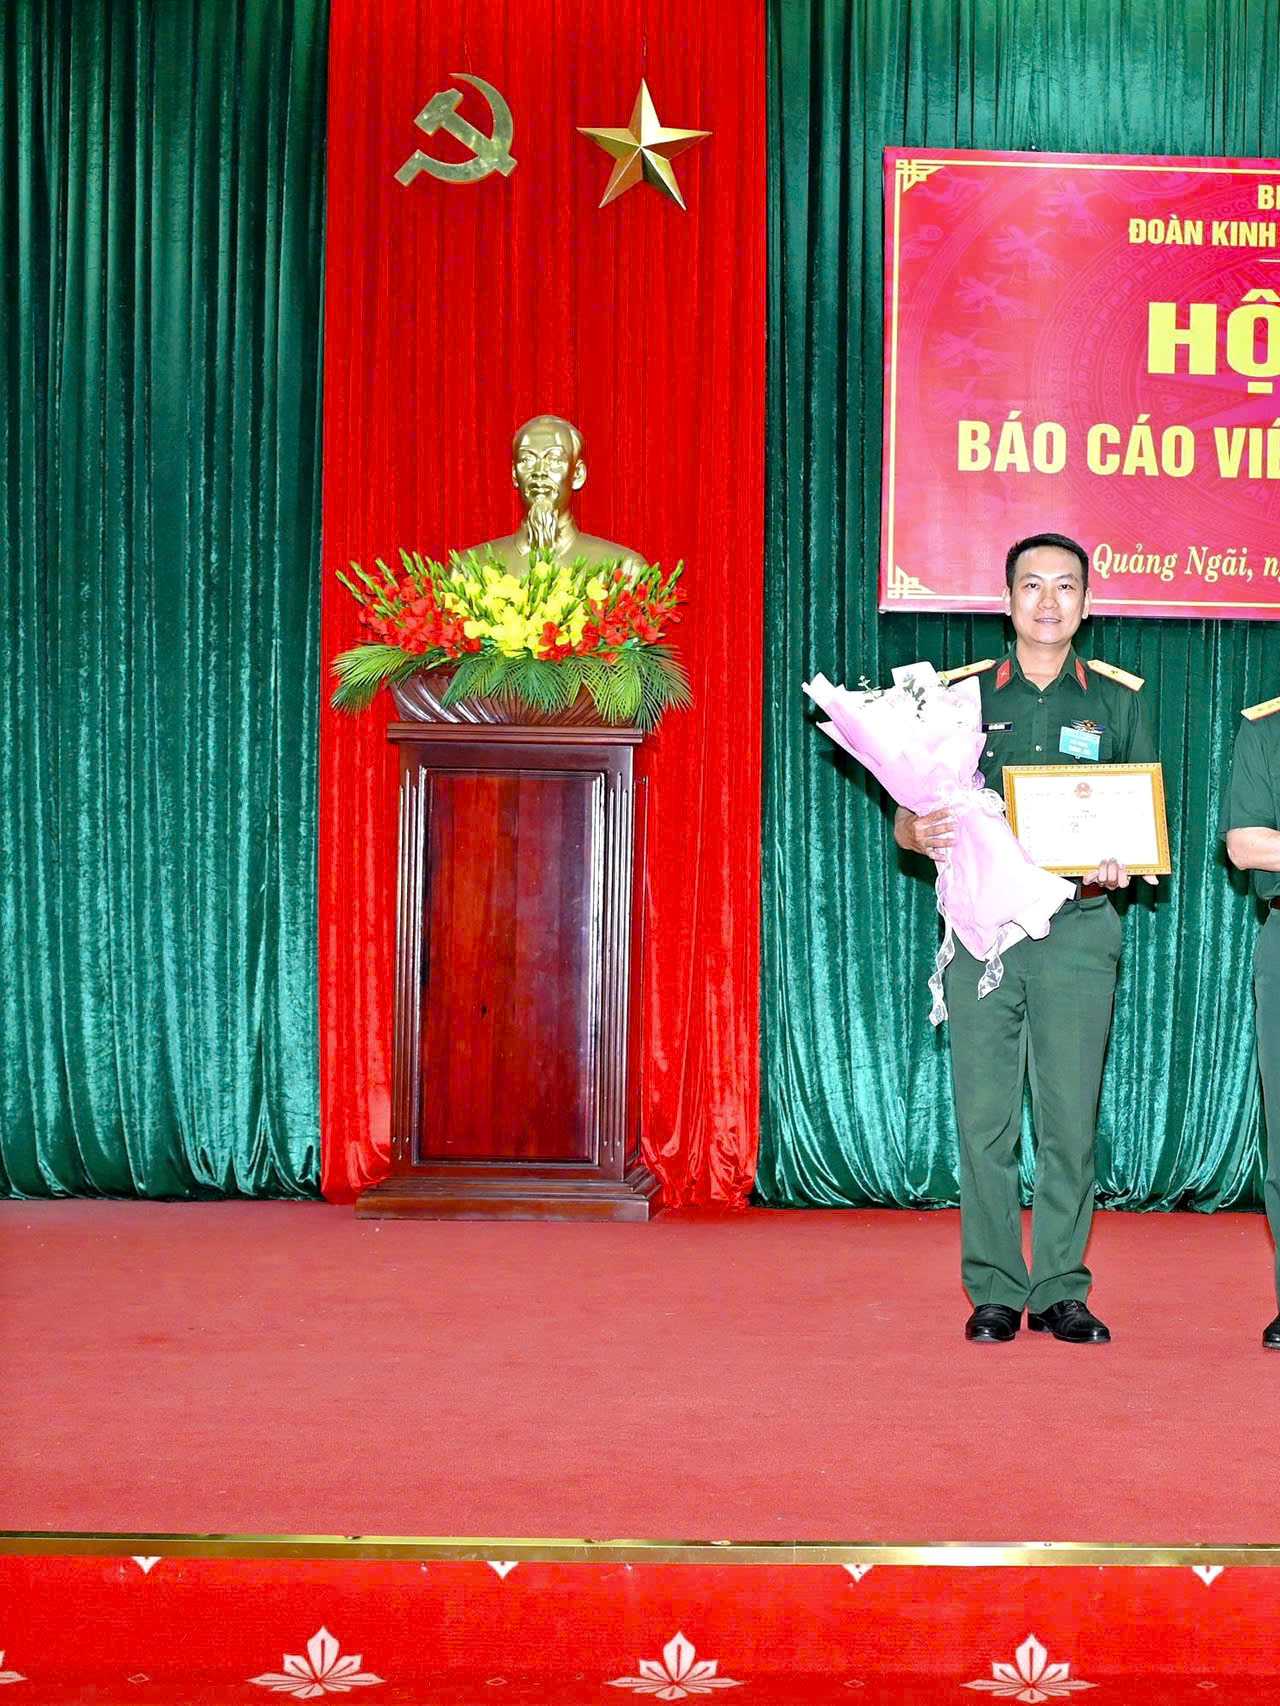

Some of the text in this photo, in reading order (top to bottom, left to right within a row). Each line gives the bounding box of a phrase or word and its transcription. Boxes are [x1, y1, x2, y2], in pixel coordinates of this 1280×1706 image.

[1128, 214, 1203, 246] ĐOÀN
[1211, 220, 1276, 248] KINH
[958, 410, 1067, 474] BÁO
[1087, 411, 1195, 478] CÁO
[1092, 543, 1178, 582] Quảng
[1184, 546, 1254, 584] Ngãi,
